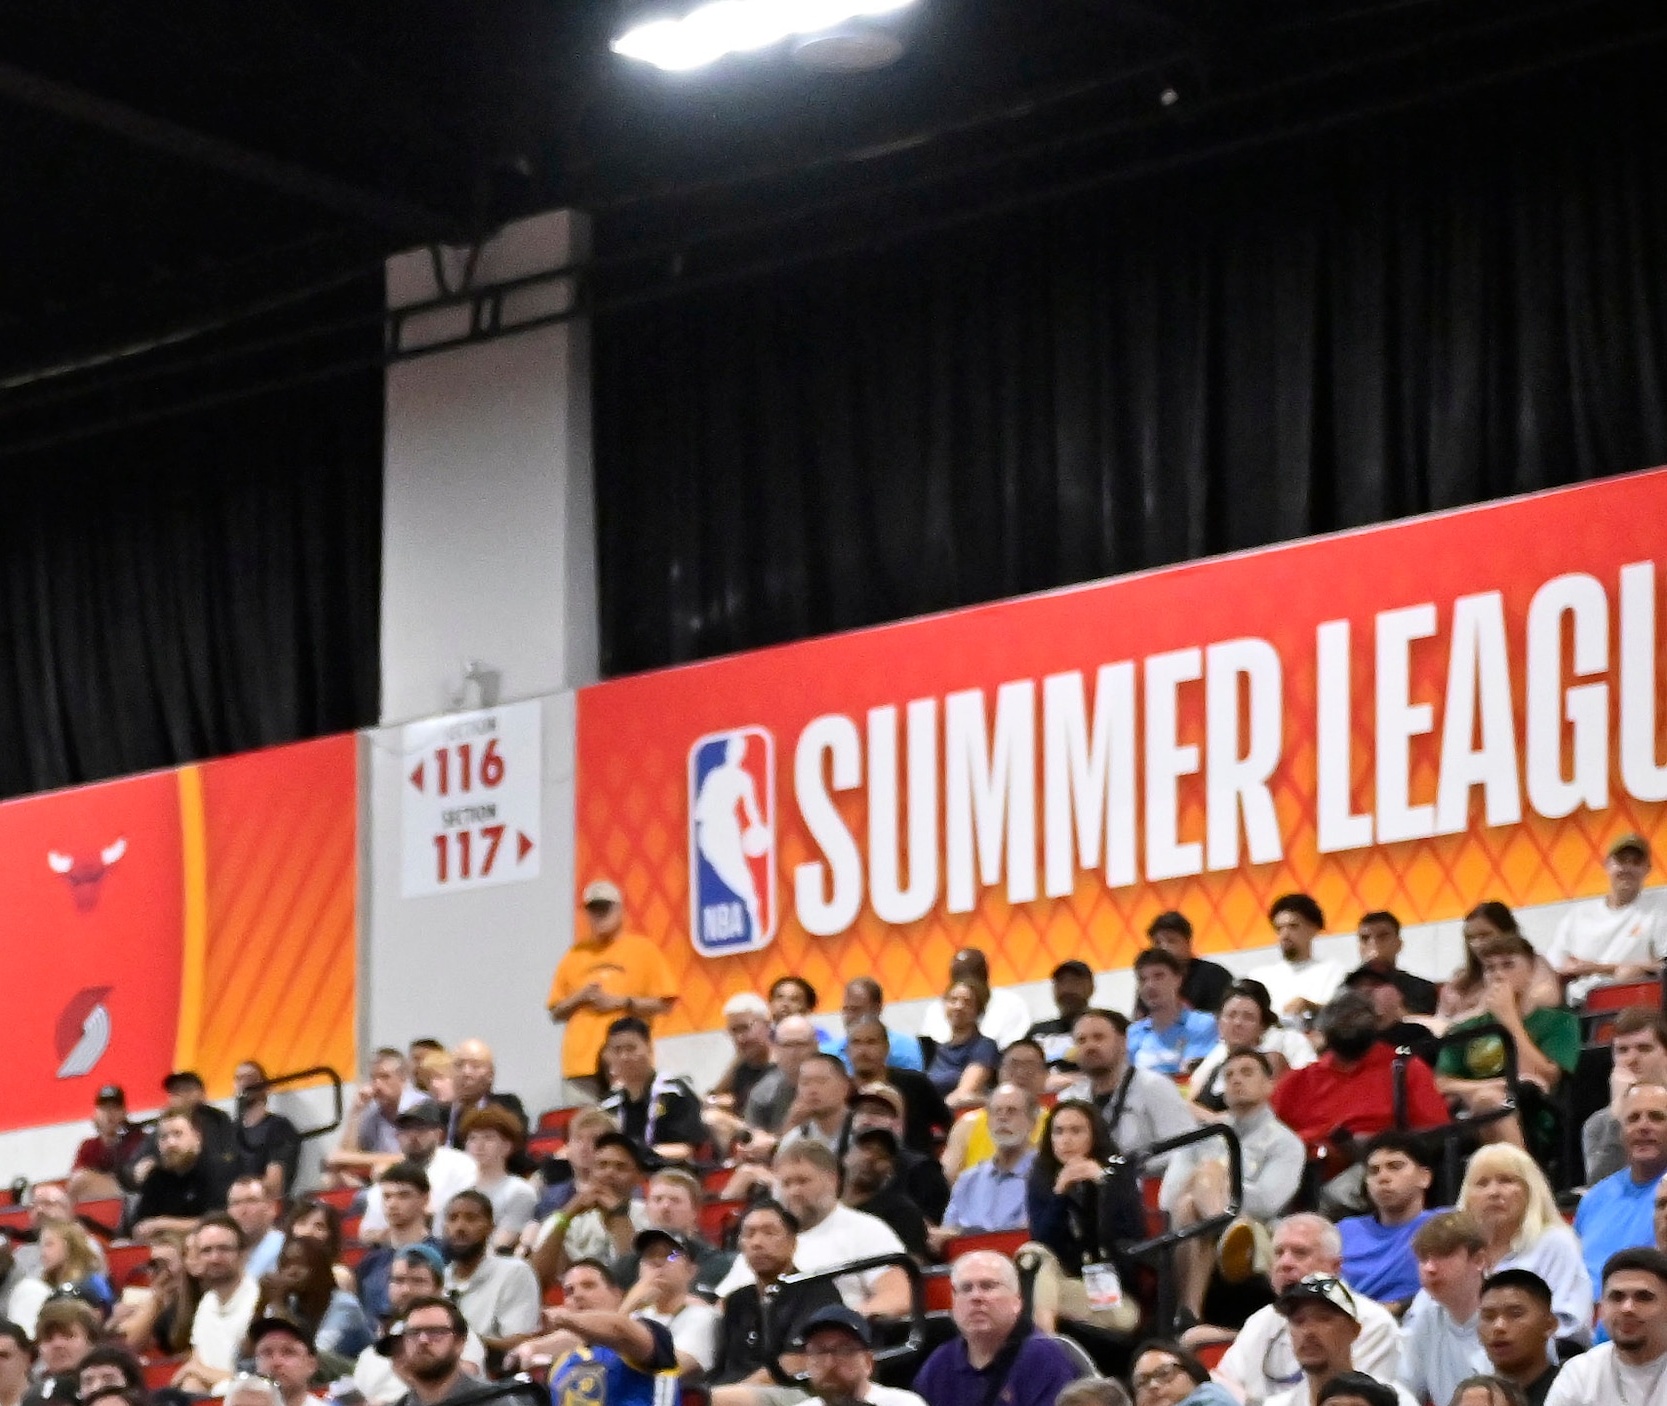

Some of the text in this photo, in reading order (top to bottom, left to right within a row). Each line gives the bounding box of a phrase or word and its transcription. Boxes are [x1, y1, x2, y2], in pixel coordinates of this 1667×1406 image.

[434, 738, 505, 797] 116
[794, 559, 1667, 938] SUMMER LEAGU
[433, 823, 507, 884] 117
[703, 902, 745, 942] NBA
